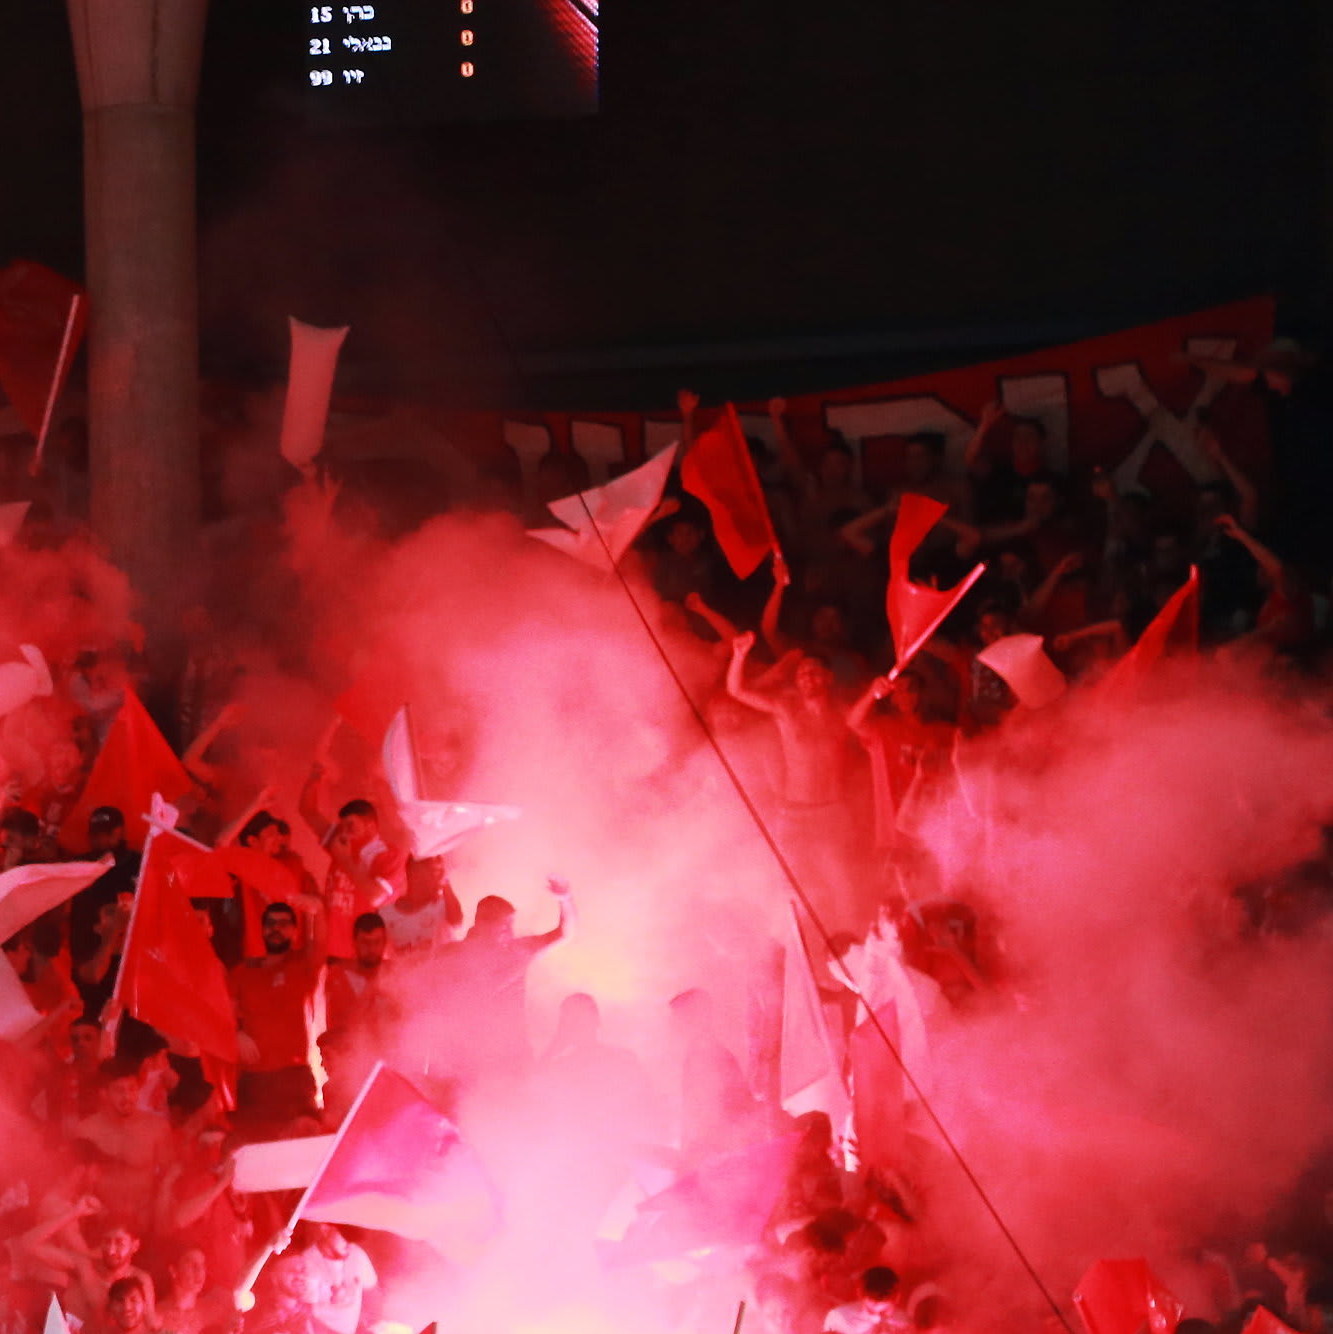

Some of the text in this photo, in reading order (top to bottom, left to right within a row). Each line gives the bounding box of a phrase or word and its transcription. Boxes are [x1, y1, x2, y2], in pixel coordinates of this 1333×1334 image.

[310, 6, 333, 23] 15
[309, 38, 332, 55] 21
[460, 30, 474, 46] 0
[309, 69, 333, 86] 99
[460, 62, 474, 77] 0
